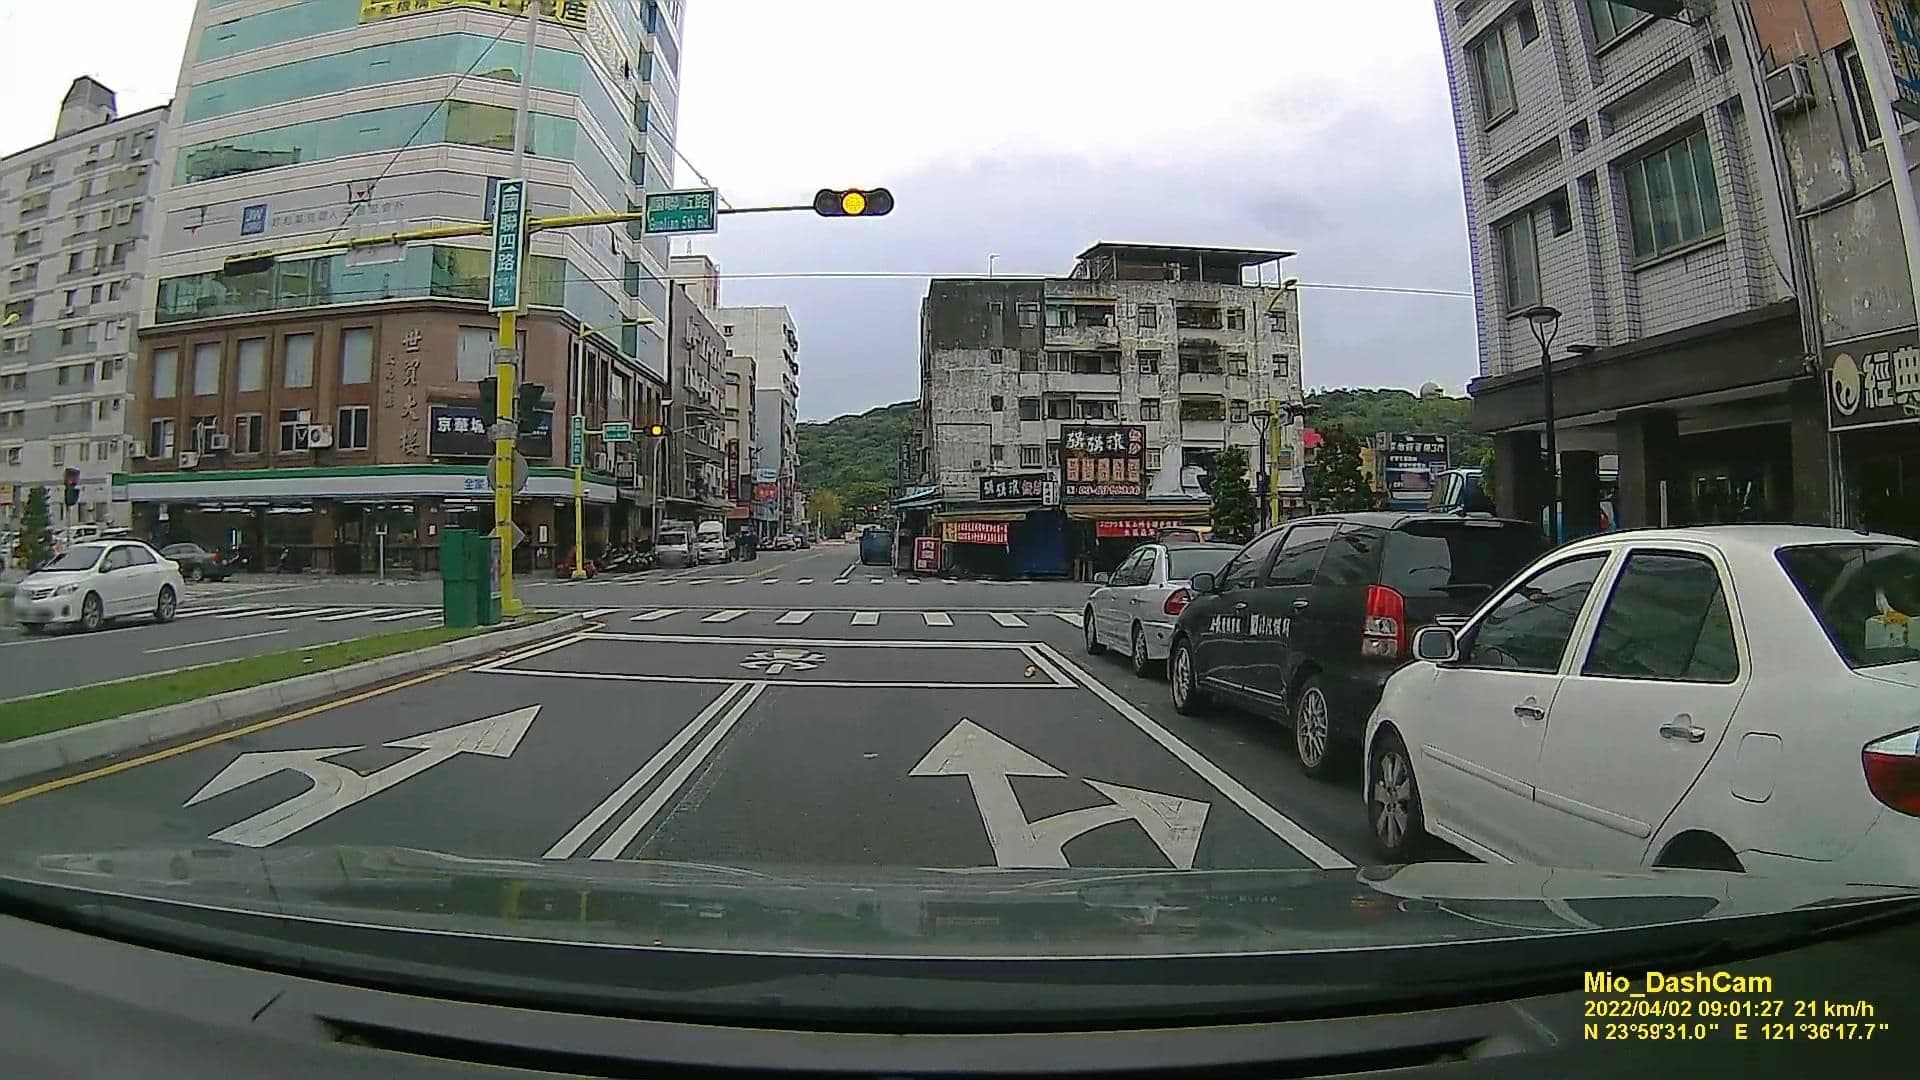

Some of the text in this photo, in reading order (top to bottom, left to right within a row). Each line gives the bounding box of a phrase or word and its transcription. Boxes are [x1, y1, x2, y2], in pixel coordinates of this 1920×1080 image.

[497, 193, 520, 272] 國聯四路
[401, 327, 422, 457] 世貿大樓
